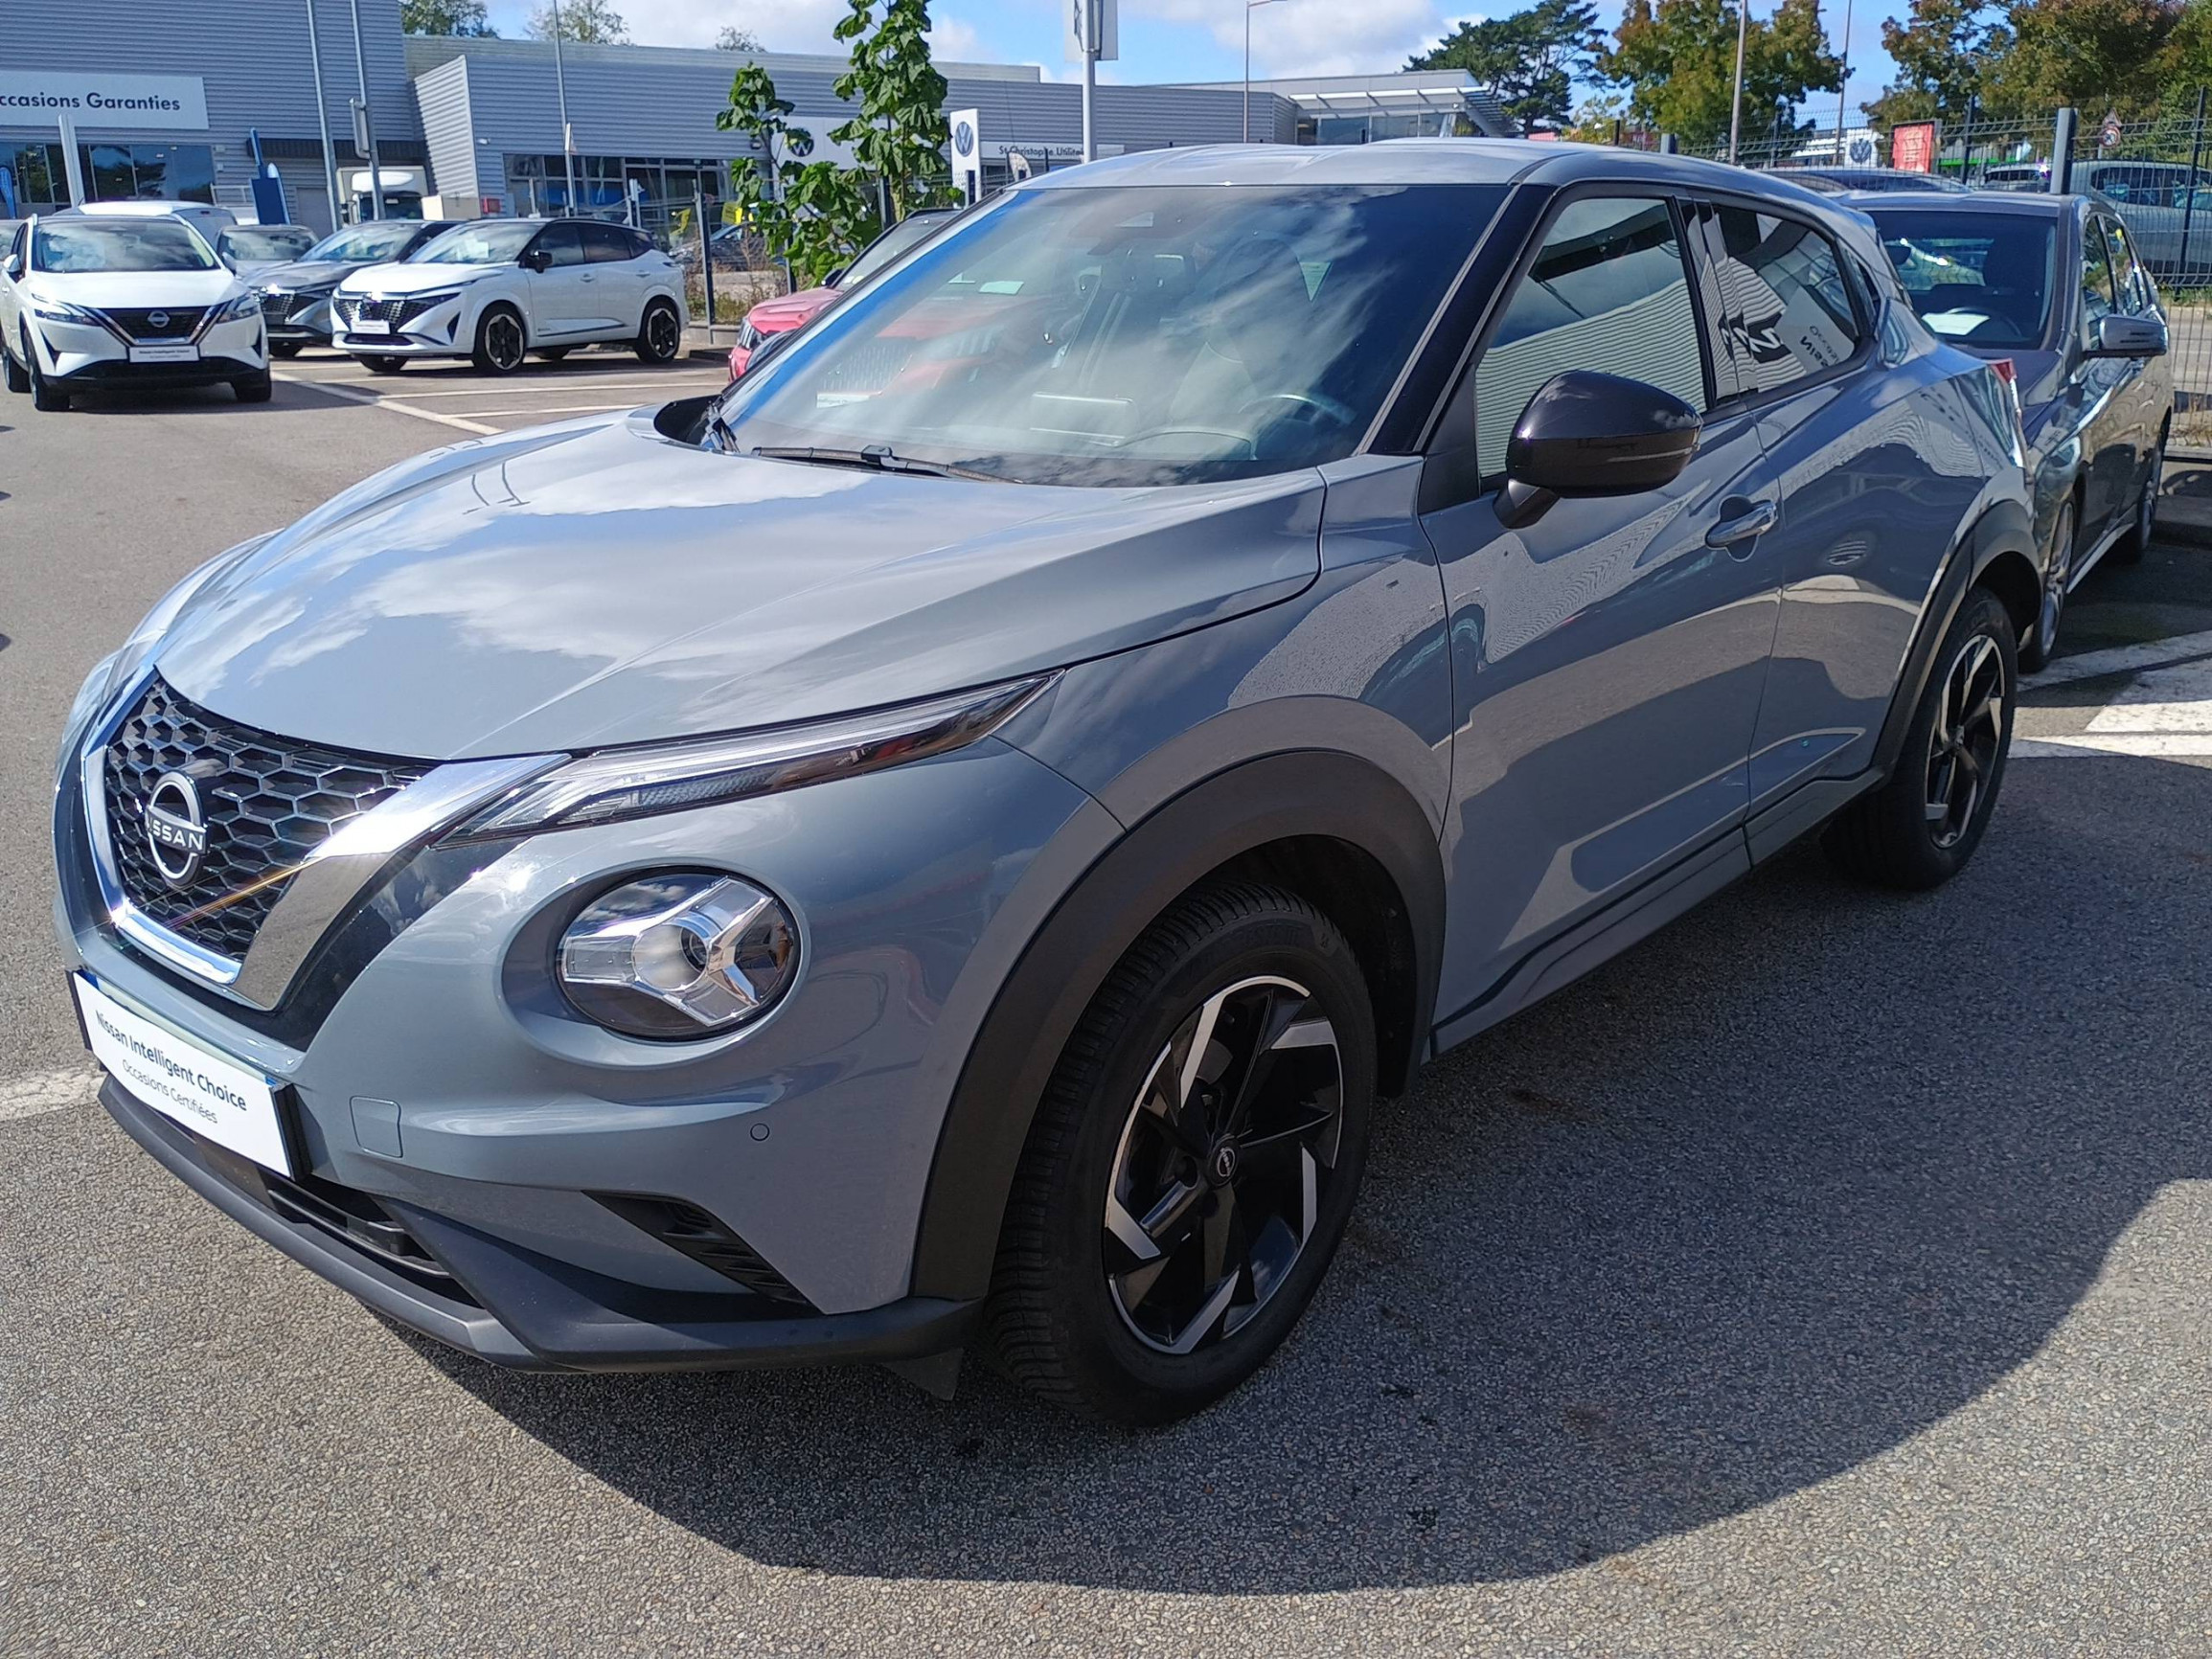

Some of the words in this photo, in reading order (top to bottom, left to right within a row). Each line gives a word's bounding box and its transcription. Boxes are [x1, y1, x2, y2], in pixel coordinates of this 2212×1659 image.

[86, 92, 180, 110] Garanties
[1010, 146, 1053, 157] Christope
[95, 1010, 129, 1046] Nissan
[129, 1034, 195, 1086] Intelligent
[197, 1074, 247, 1112] Choice
[123, 1058, 170, 1097] Occasions
[171, 1087, 218, 1124] Certifiées
